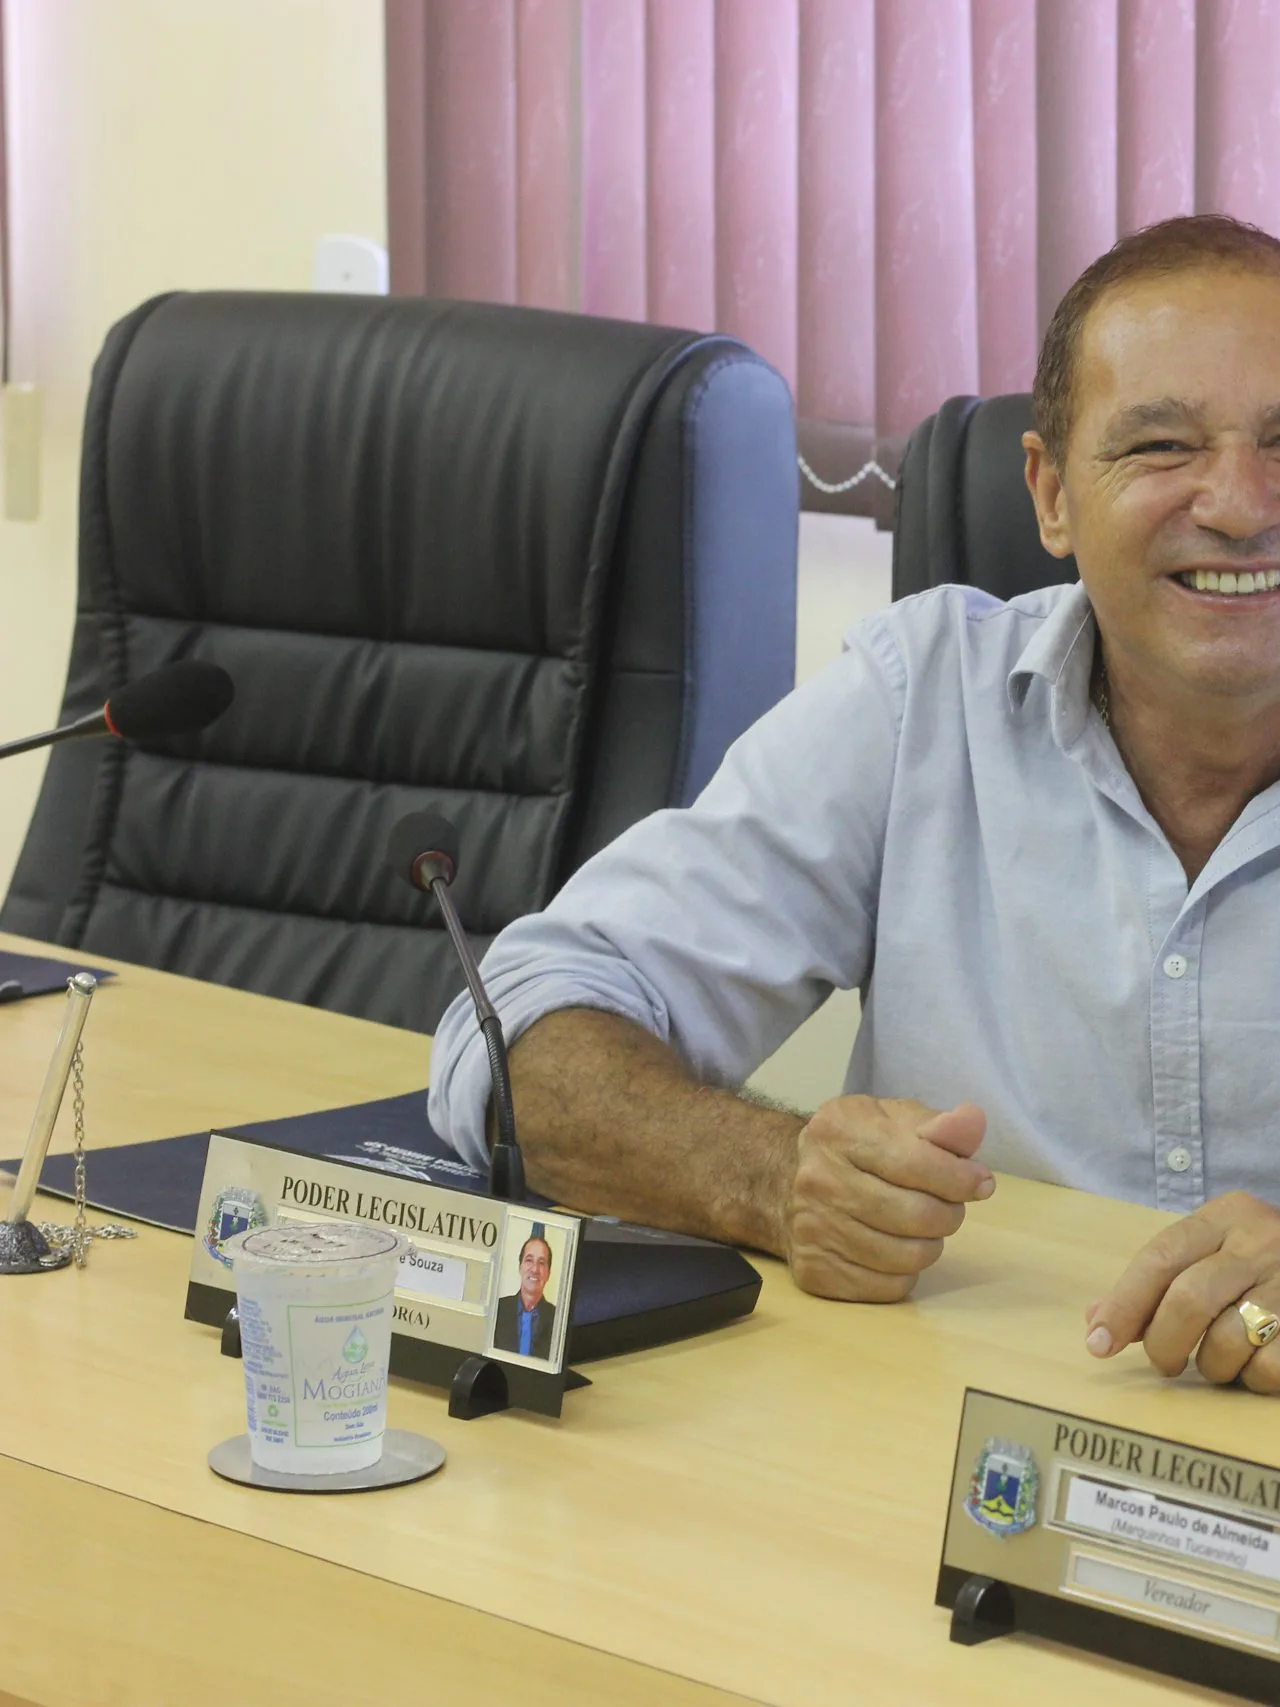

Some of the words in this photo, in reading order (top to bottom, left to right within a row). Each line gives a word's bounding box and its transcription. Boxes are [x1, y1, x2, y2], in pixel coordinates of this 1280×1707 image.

[281, 1176, 350, 1213] PODER
[356, 1193, 498, 1248] LEGISLATIVO
[408, 1254, 444, 1273] Souza
[1053, 1423, 1143, 1473] PODER
[1096, 1490, 1145, 1518] Marcos
[1148, 1504, 1188, 1531] Paulo
[1191, 1515, 1209, 1535] de
[1211, 1520, 1270, 1552] Almeida
[1111, 1517, 1181, 1551] (Marquinhos
[1184, 1537, 1248, 1569] Tucaninho)
[1143, 1579, 1212, 1615] Vereador
